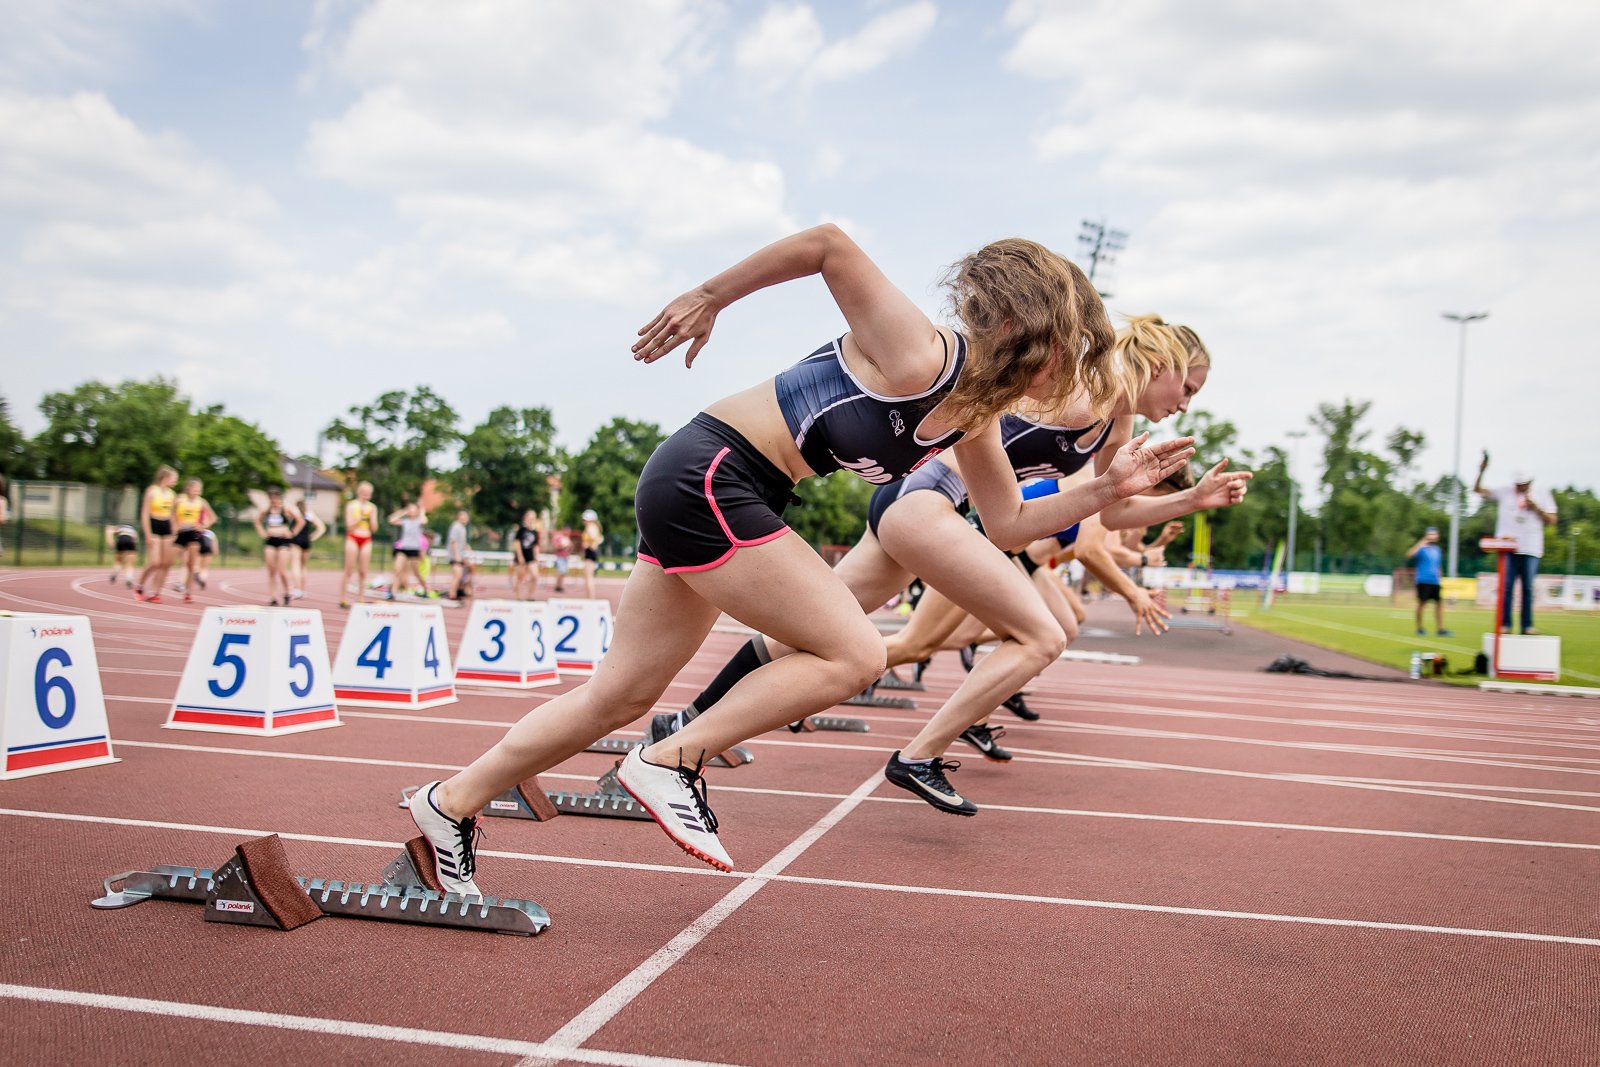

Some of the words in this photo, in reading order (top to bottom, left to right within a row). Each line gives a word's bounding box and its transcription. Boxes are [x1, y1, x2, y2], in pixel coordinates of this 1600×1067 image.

[355, 625, 393, 680] 4
[423, 626, 440, 679] 4
[478, 618, 507, 663] 3
[531, 619, 546, 663] 3
[553, 614, 581, 655] 2
[34, 646, 77, 730] 6
[207, 632, 252, 698] 5
[288, 634, 315, 698] 5
[226, 902, 252, 911] polanik
